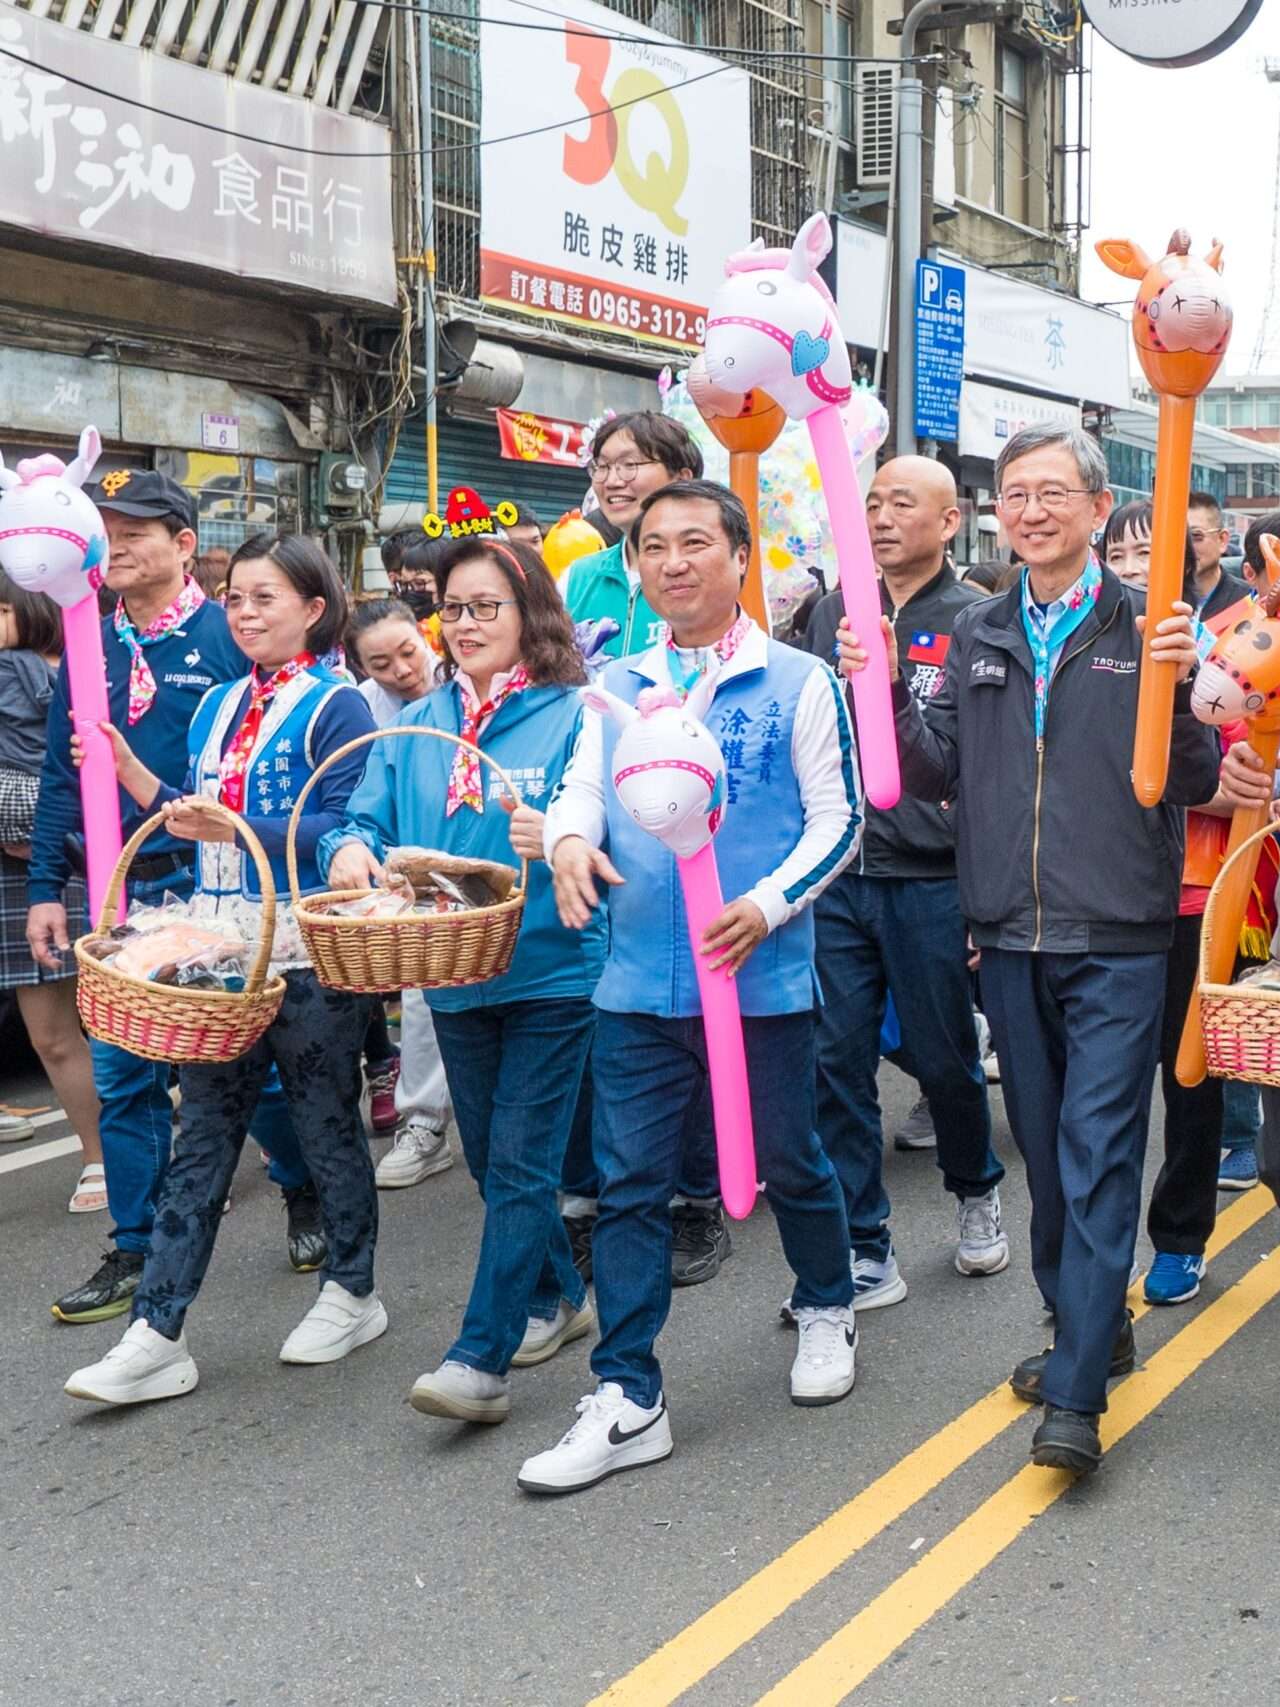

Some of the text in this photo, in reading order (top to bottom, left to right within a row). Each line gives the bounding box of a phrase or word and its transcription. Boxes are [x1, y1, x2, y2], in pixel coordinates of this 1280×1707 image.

[563, 19, 689, 237] 3Q
[211, 152, 366, 247] 食品行
[563, 210, 689, 286] 脆皮雞排
[924, 269, 939, 302] P
[510, 270, 584, 315] 訂餐電話
[1043, 312, 1066, 371] 茶
[275, 736, 294, 820] 桃園市政
[758, 700, 782, 785] 立法委員
